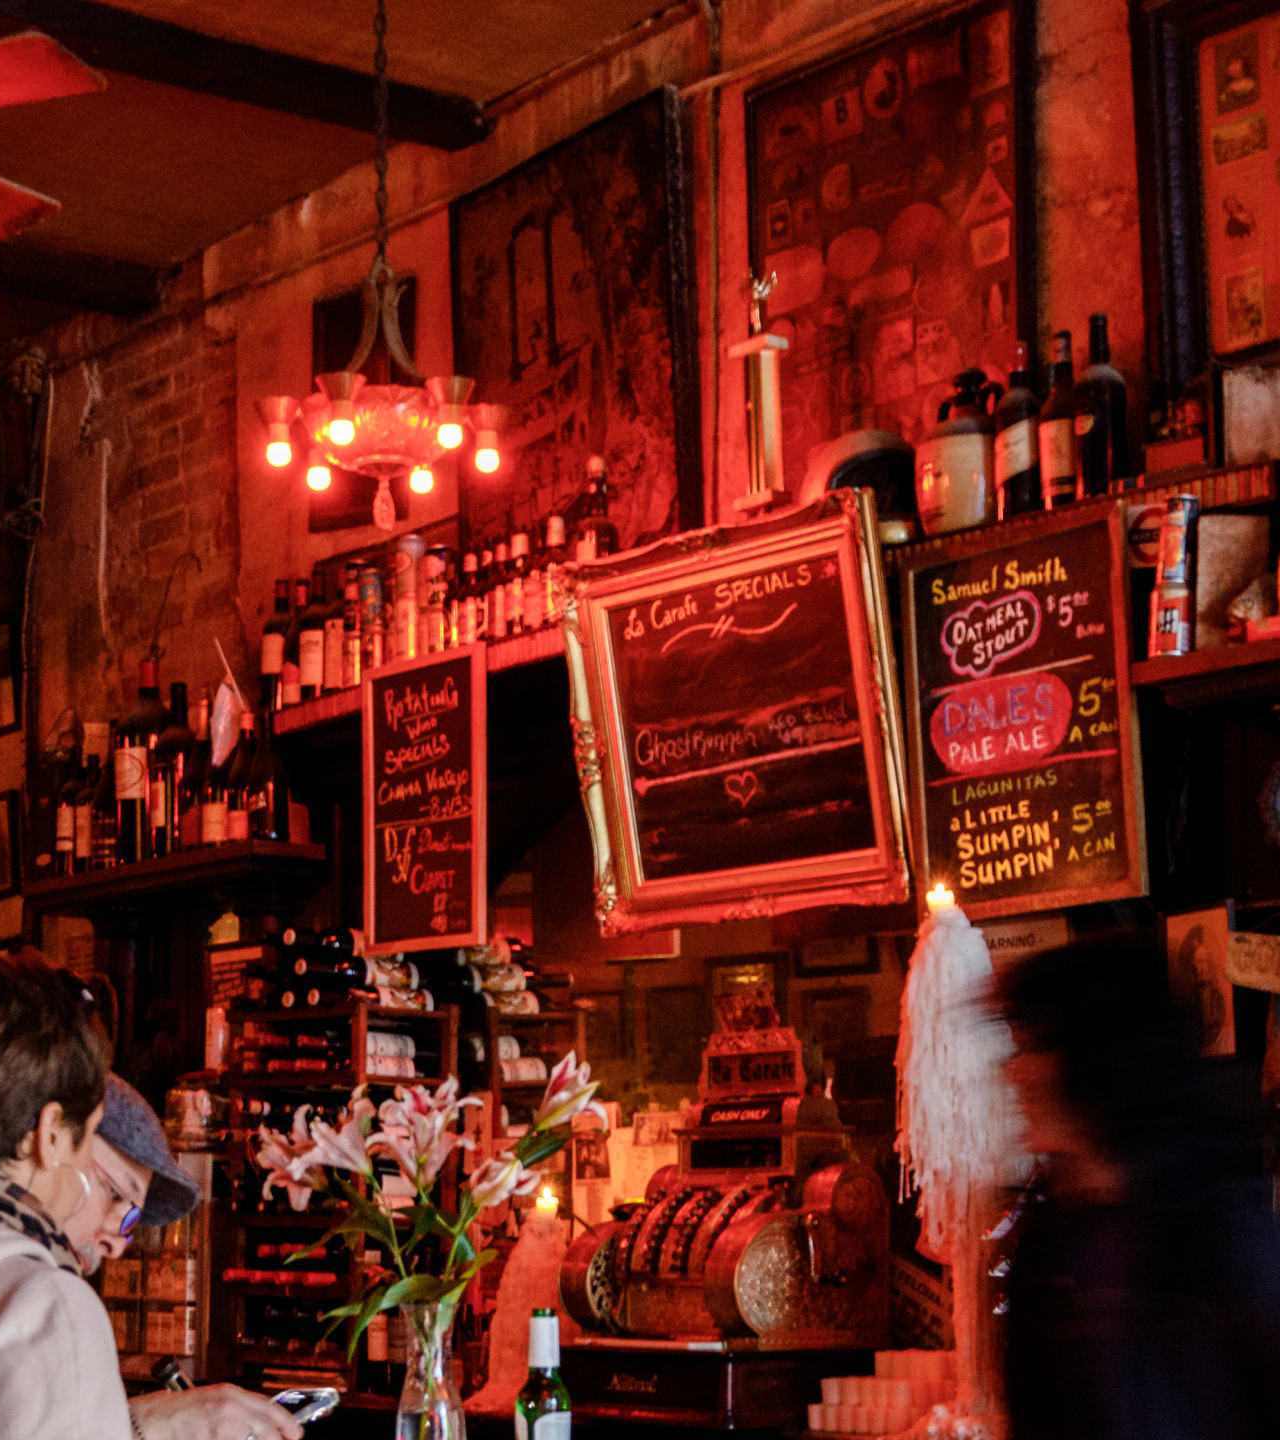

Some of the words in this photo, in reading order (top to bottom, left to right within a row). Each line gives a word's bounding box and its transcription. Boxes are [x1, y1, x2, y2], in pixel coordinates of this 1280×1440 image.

[714, 562, 813, 610] SPECIALS
[931, 565, 998, 605] Samuel
[1003, 556, 1069, 591] Smith
[972, 620, 1029, 675] STOUT
[947, 735, 996, 767] PALE
[1005, 725, 1050, 755] ALE
[950, 768, 1059, 806] LAGUNITAS
[963, 799, 1031, 830] LITTLE
[1082, 831, 1117, 858] CAN
[985, 932, 1036, 951] ARNING
